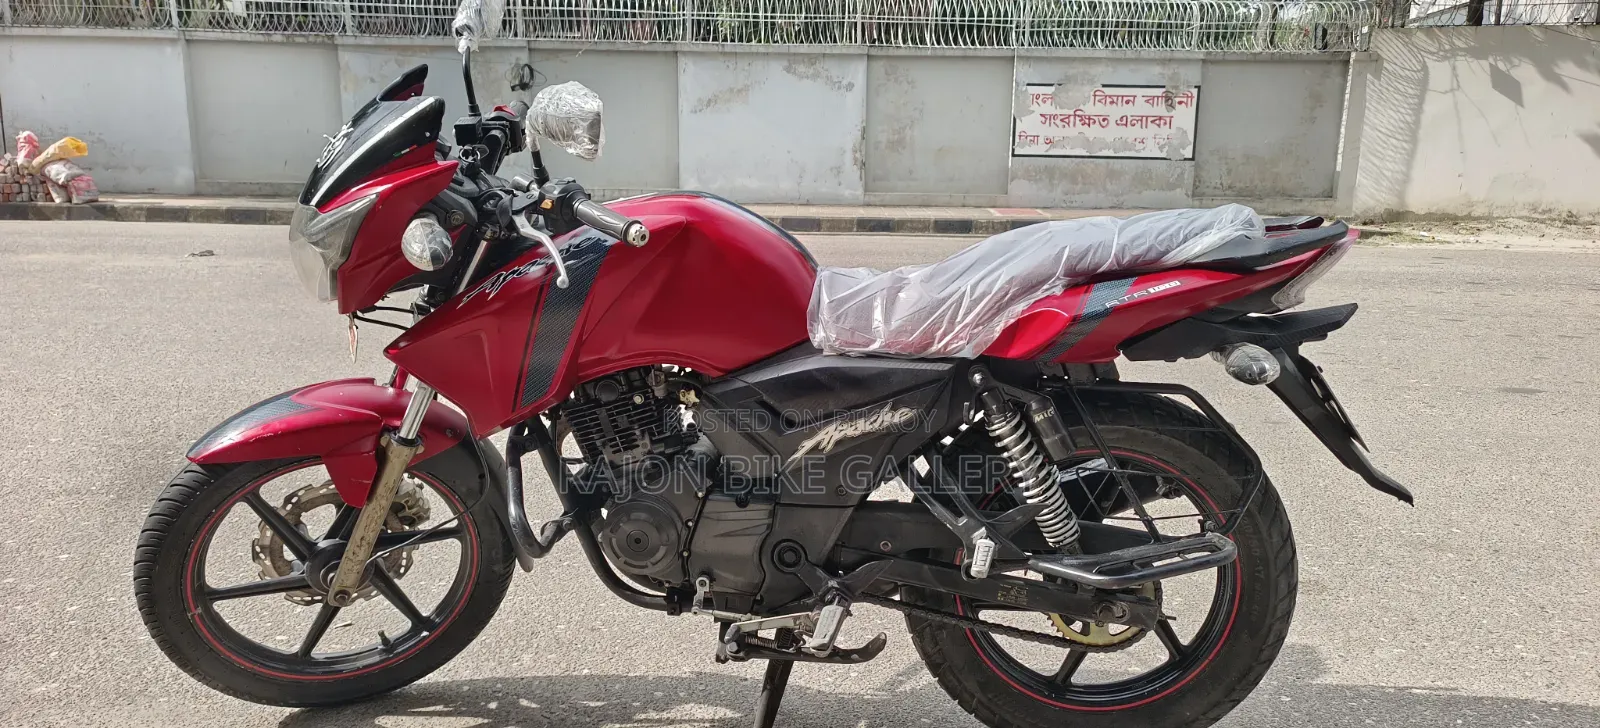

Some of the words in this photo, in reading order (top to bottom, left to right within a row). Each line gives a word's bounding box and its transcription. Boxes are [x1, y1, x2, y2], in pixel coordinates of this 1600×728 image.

[1092, 90, 1137, 107] বিমান
[1142, 91, 1195, 111] বাহিনী
[1040, 109, 1110, 128] সংরক্ষিত
[1115, 115, 1174, 129] এলাকা
[1105, 290, 1148, 308] RTR
[787, 401, 917, 462] Apache
